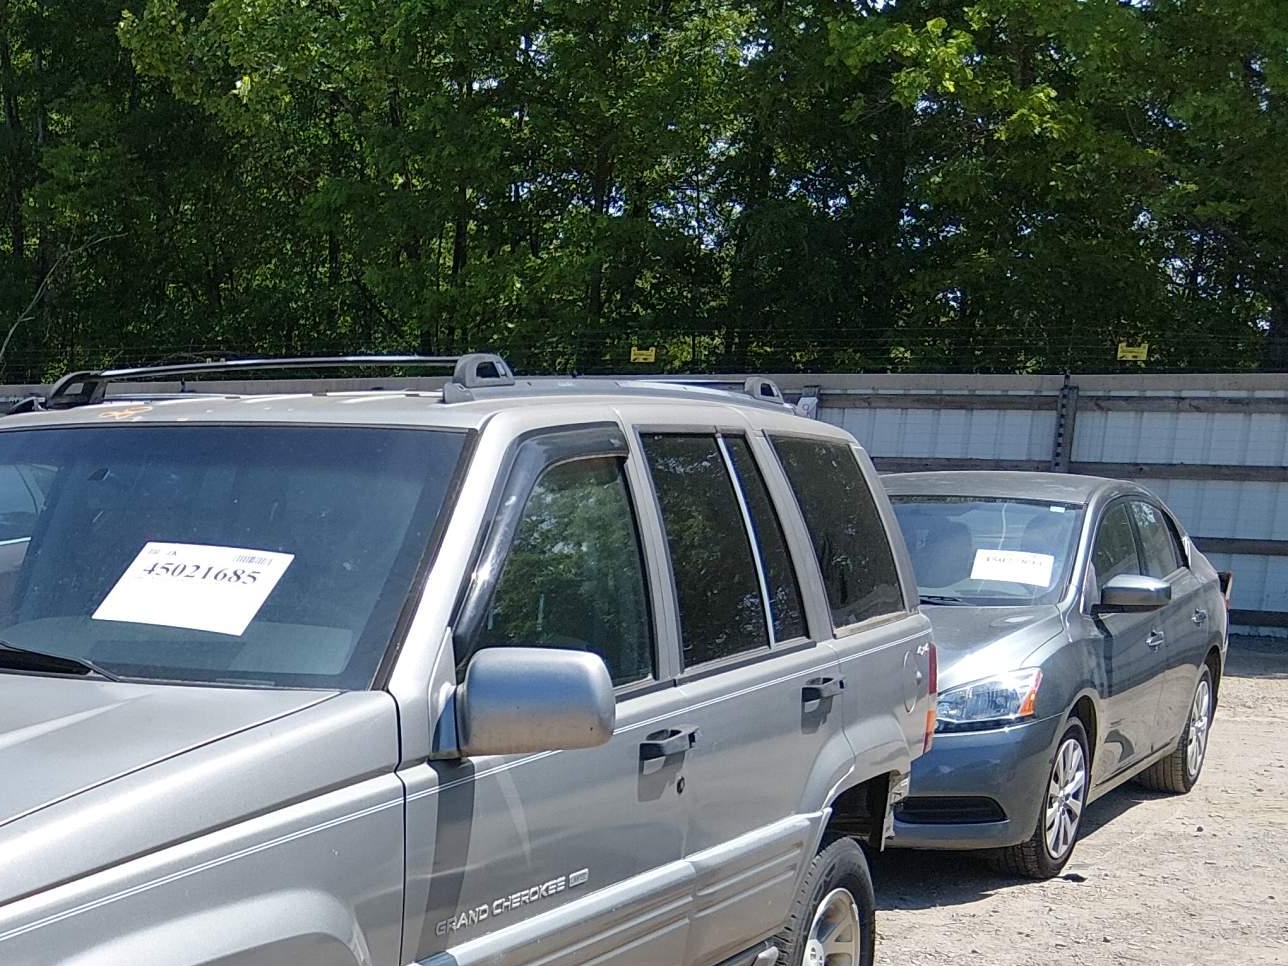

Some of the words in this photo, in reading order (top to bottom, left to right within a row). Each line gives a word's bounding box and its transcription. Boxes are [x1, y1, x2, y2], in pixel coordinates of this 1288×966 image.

[143, 561, 262, 585] 45021685
[435, 903, 489, 936] GRAND
[492, 876, 566, 916] CHEROKEE
